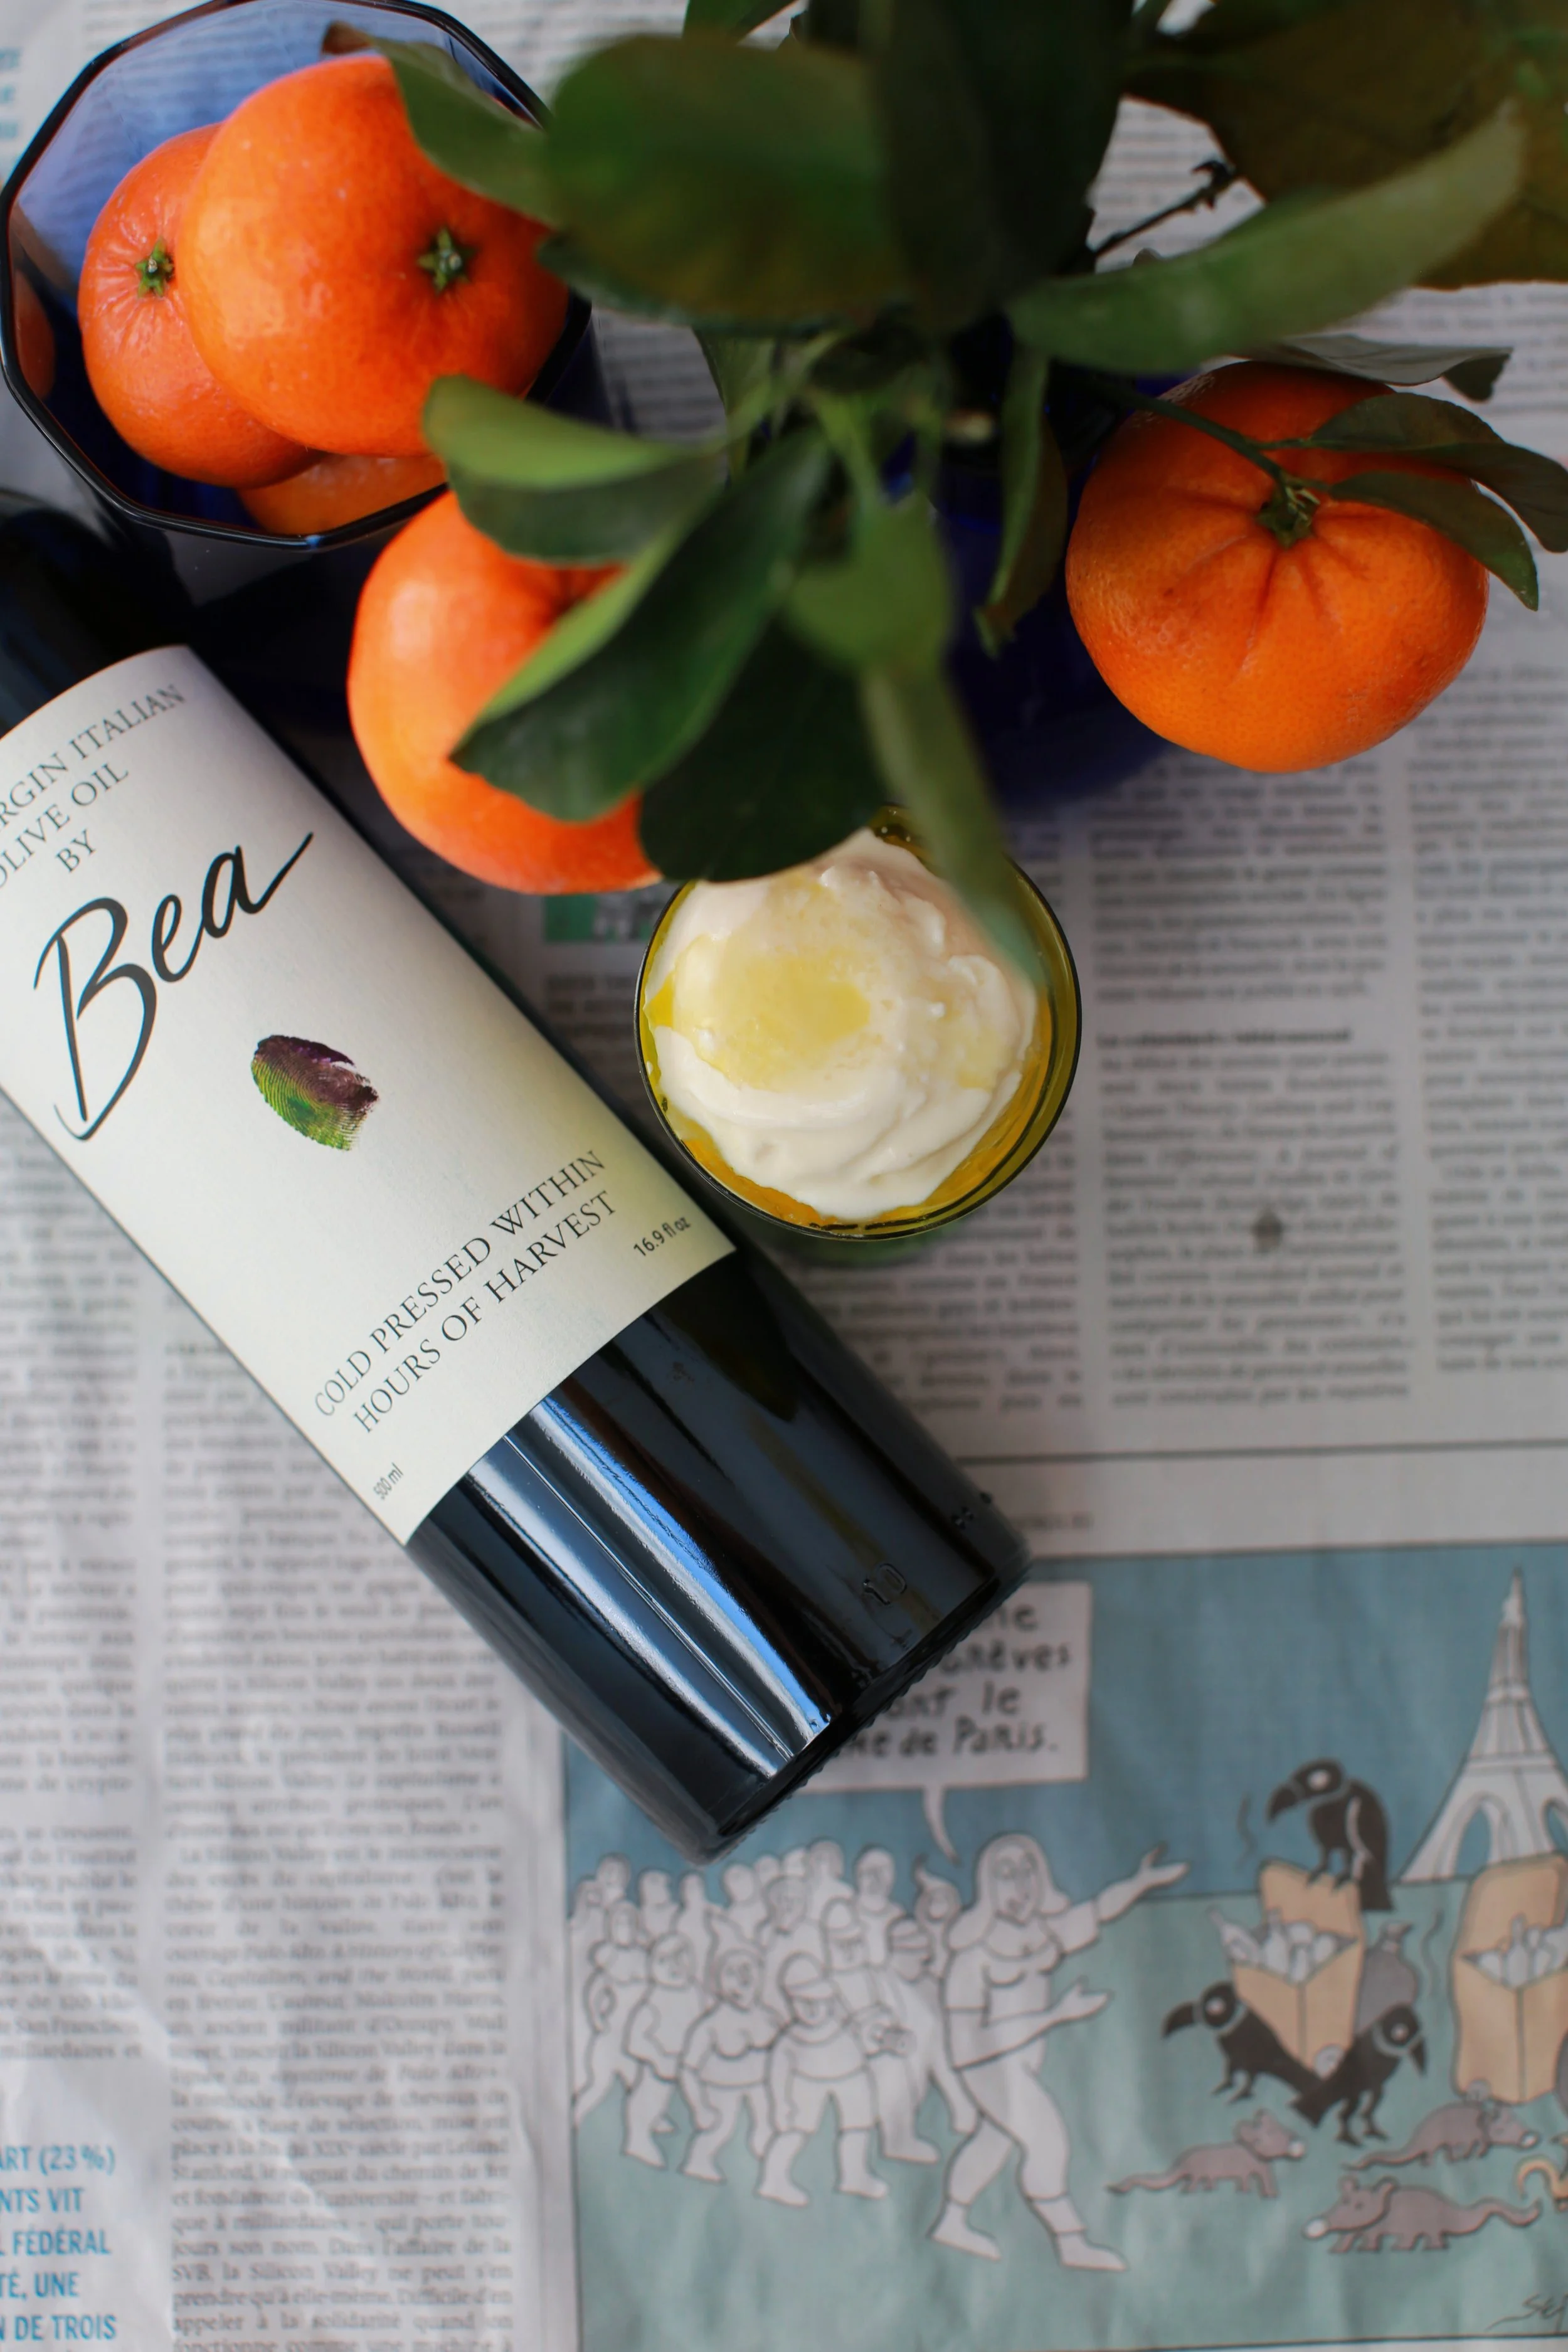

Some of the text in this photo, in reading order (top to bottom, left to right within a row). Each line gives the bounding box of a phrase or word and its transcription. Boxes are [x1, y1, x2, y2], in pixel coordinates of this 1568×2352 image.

[69, 684, 186, 759] ITALIAN
[71, 763, 129, 807] OIL
[55, 829, 97, 872] BY
[33, 832, 314, 1142] Bea
[633, 1229, 665, 1257] 16.9
[315, 1350, 372, 1417] COLD
[369, 1237, 491, 1354] PRESSED
[489, 1150, 606, 1236] WITHIN
[352, 1338, 441, 1434] HOURS
[441, 1296, 482, 1342] OF
[483, 1190, 616, 1304] HARVEST
[373, 1461, 405, 1501] 500 ml
[47, 2186, 85, 2213] VIT
[13, 2224, 112, 2256] FÉDÉRAL
[34, 2271, 80, 2298] UNE
[14, 2314, 43, 2341] DE
[51, 2314, 117, 2341] TROIS
